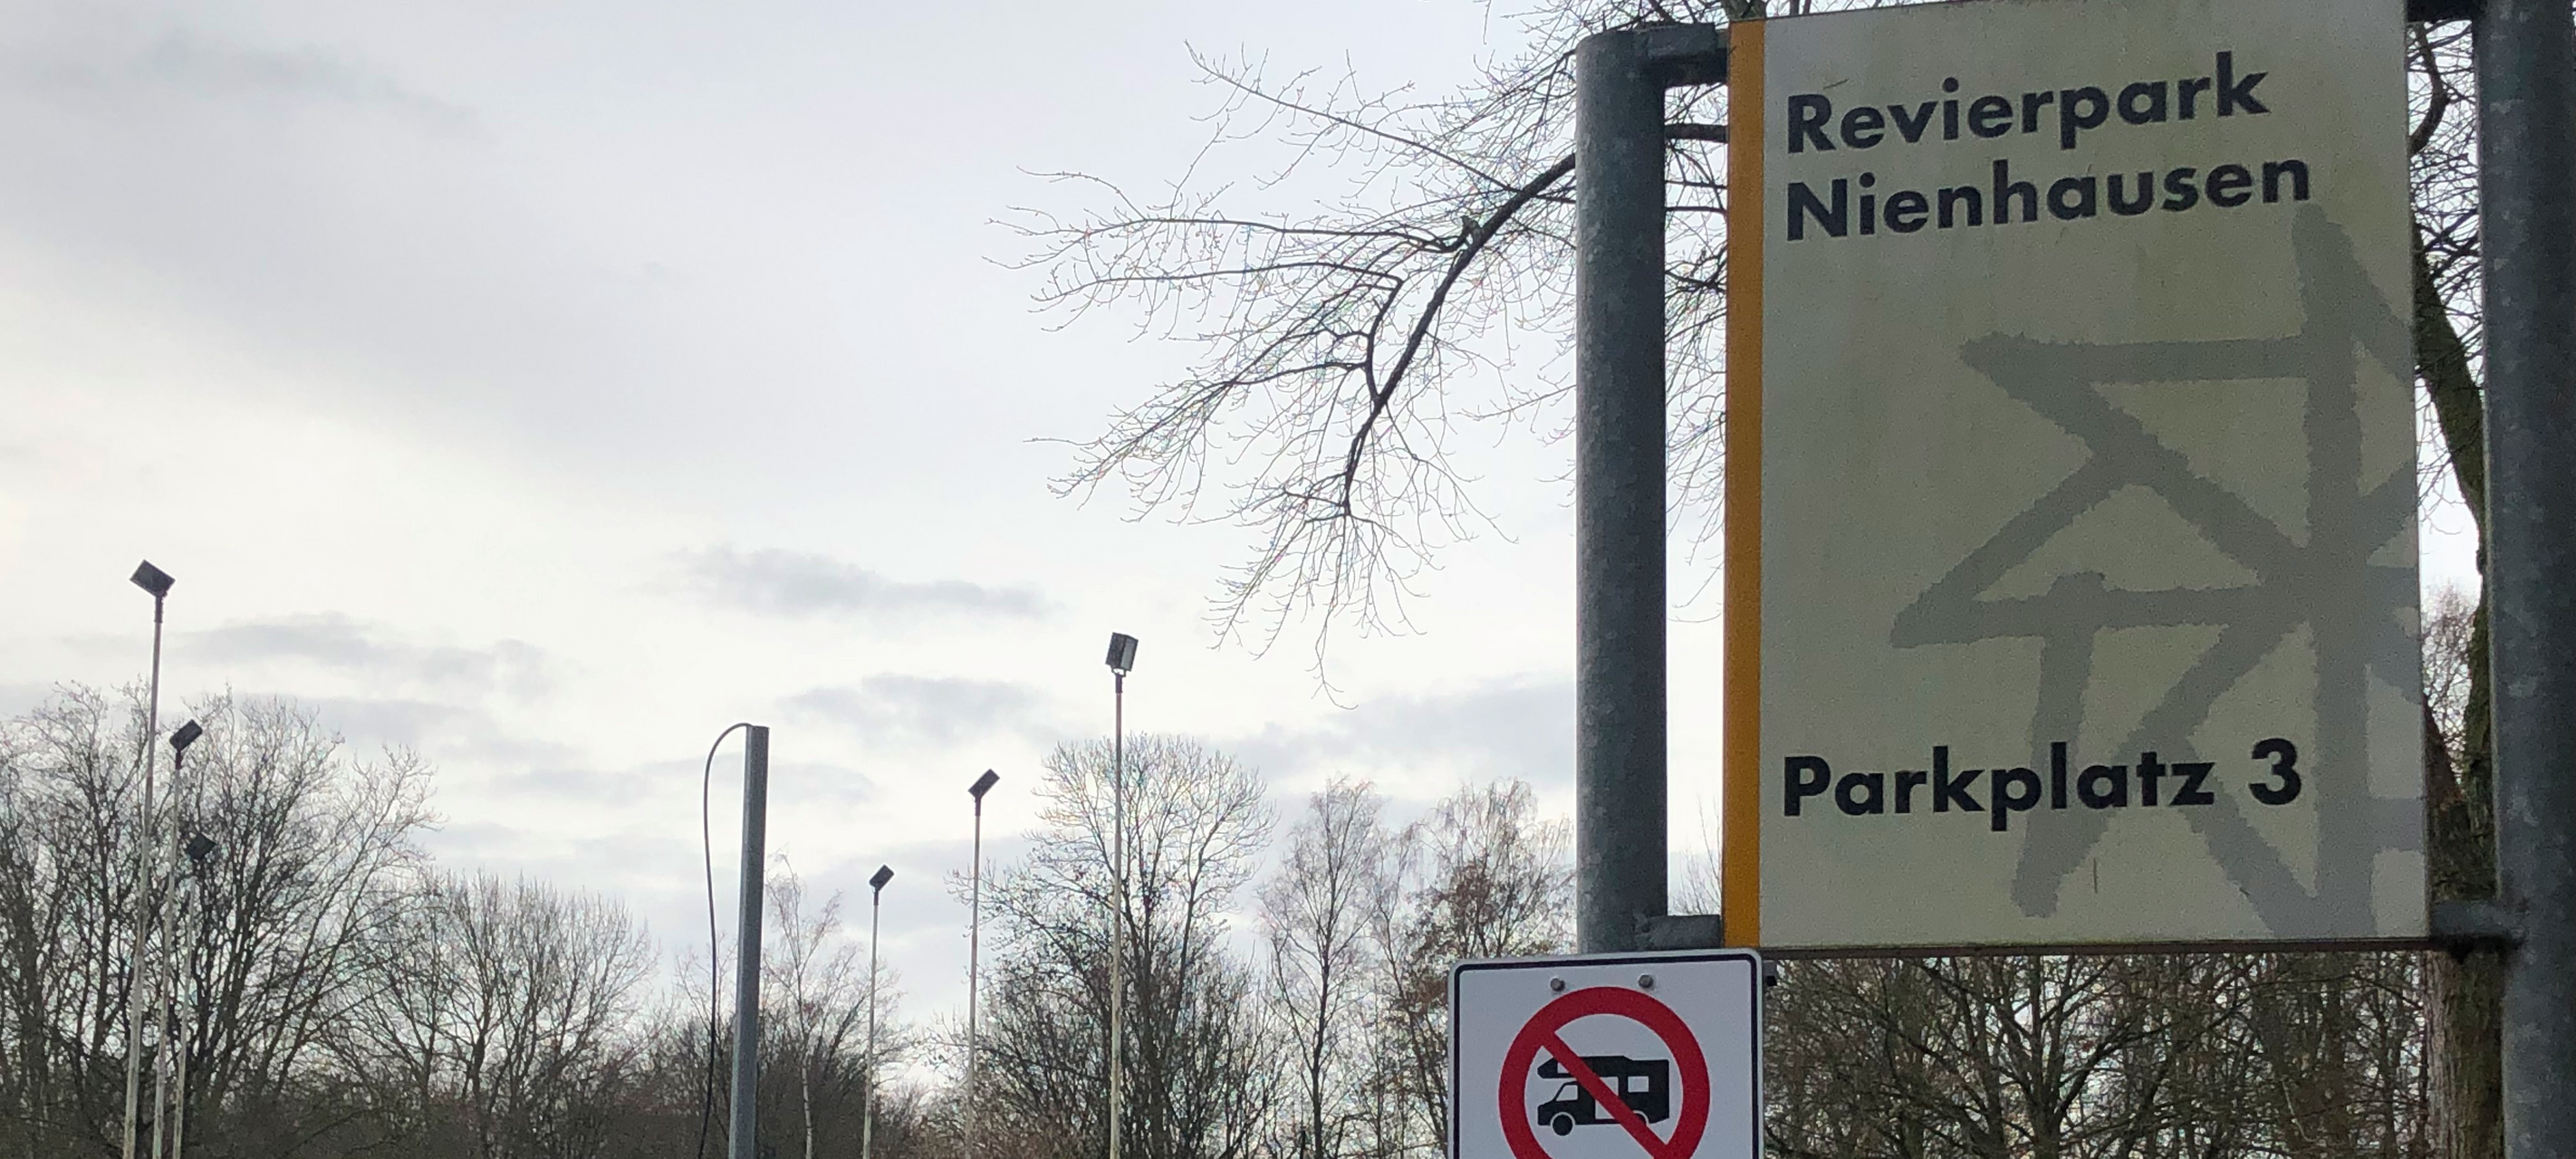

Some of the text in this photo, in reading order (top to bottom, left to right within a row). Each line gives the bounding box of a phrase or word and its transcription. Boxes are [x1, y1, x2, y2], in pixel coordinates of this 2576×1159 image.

[1786, 50, 2272, 155] Revierpark
[1785, 158, 2312, 243] Nienhausen
[1783, 737, 2303, 833] Parkplatz 3
